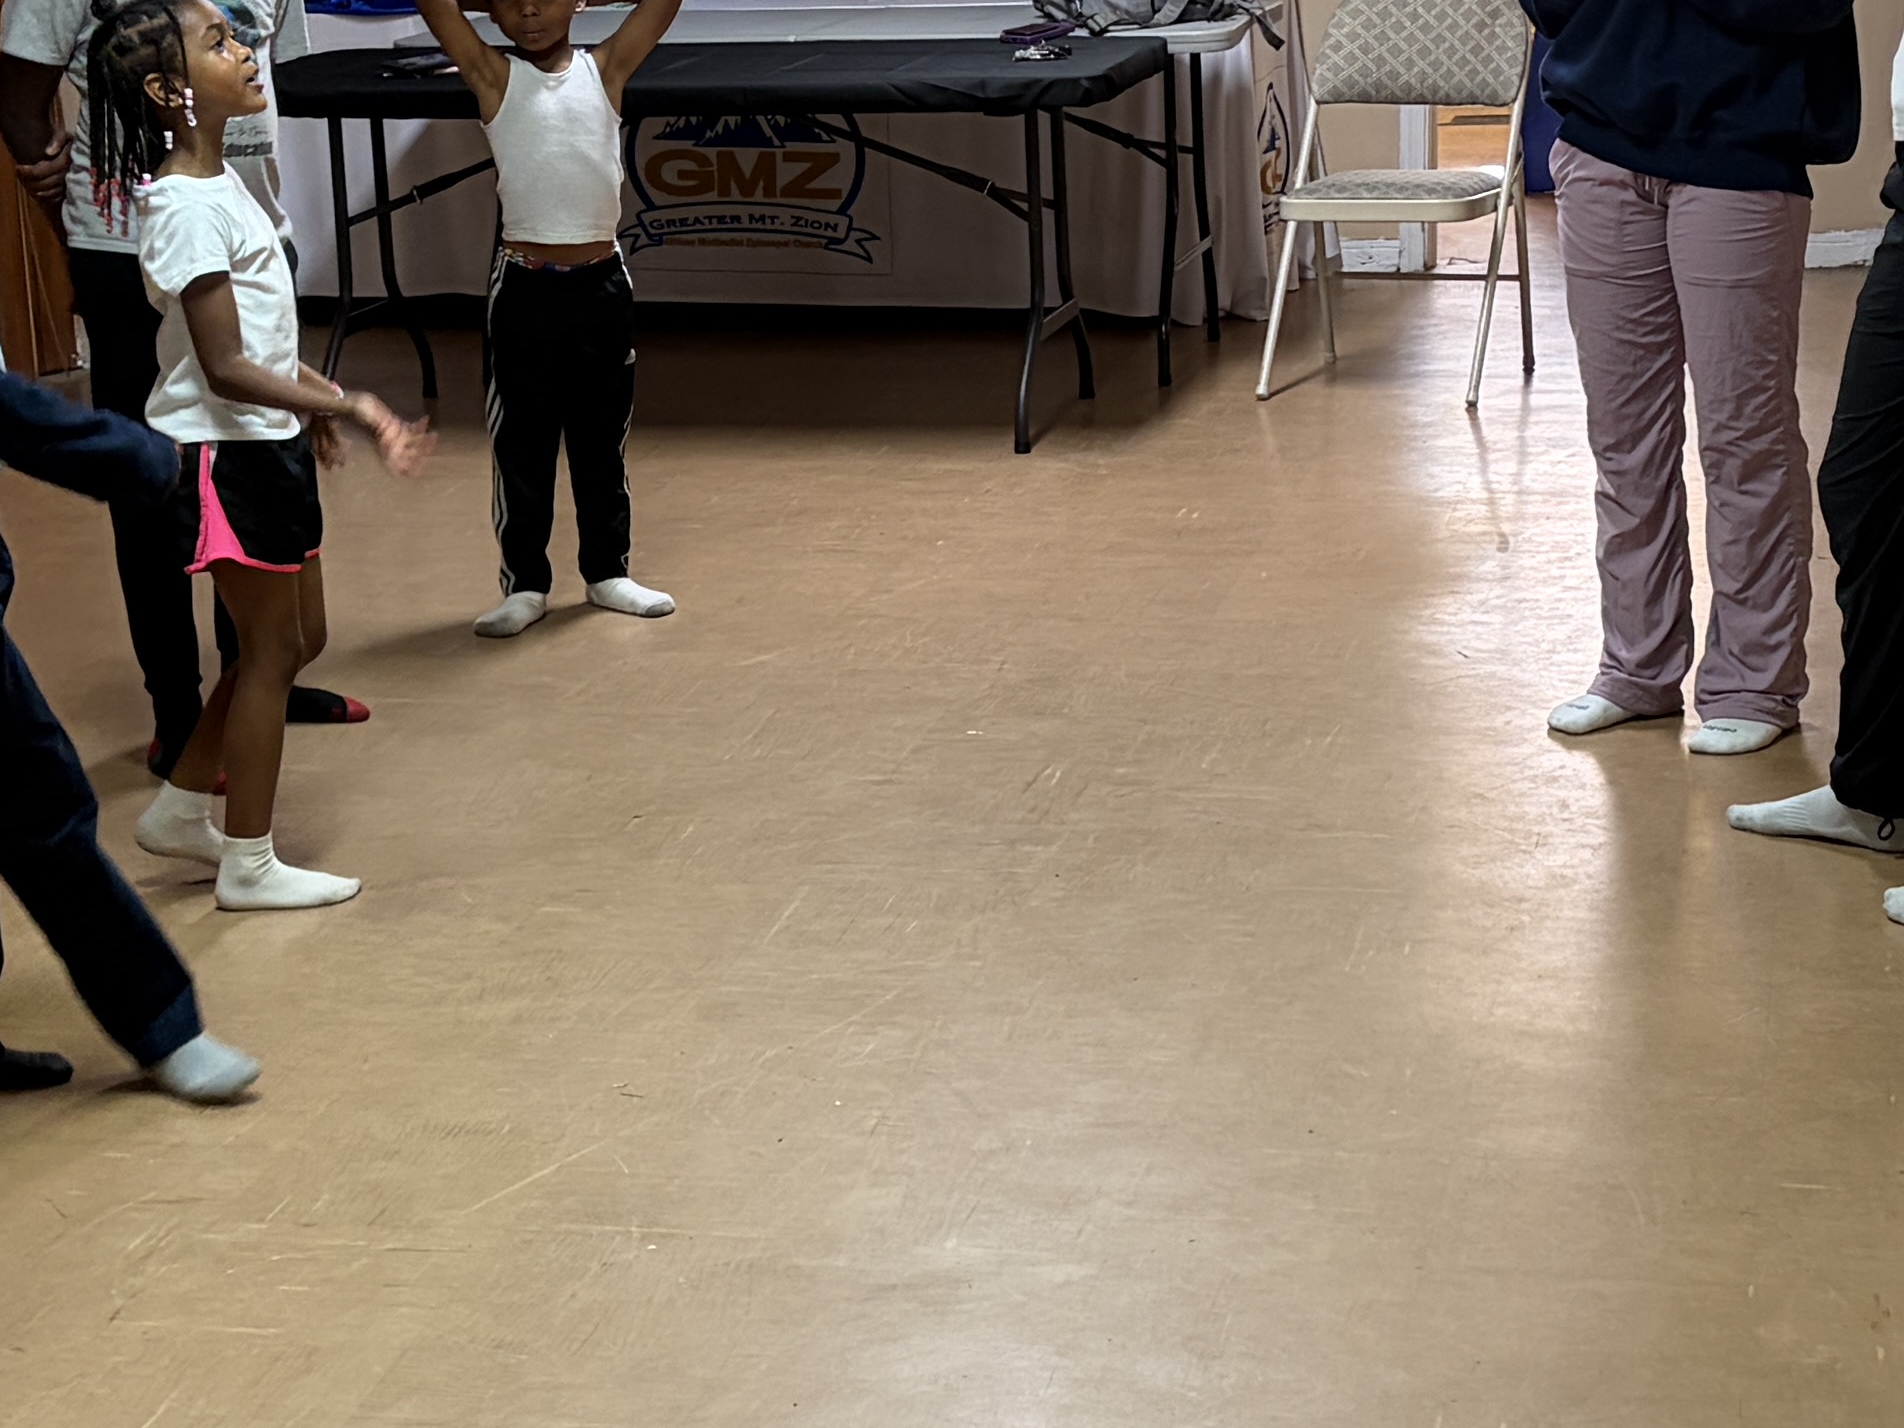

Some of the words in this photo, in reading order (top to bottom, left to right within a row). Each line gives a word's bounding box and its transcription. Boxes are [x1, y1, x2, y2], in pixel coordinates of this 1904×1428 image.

[645, 149, 843, 200] GMZ
[649, 213, 743, 231] GREATER
[789, 215, 839, 233] ZION
